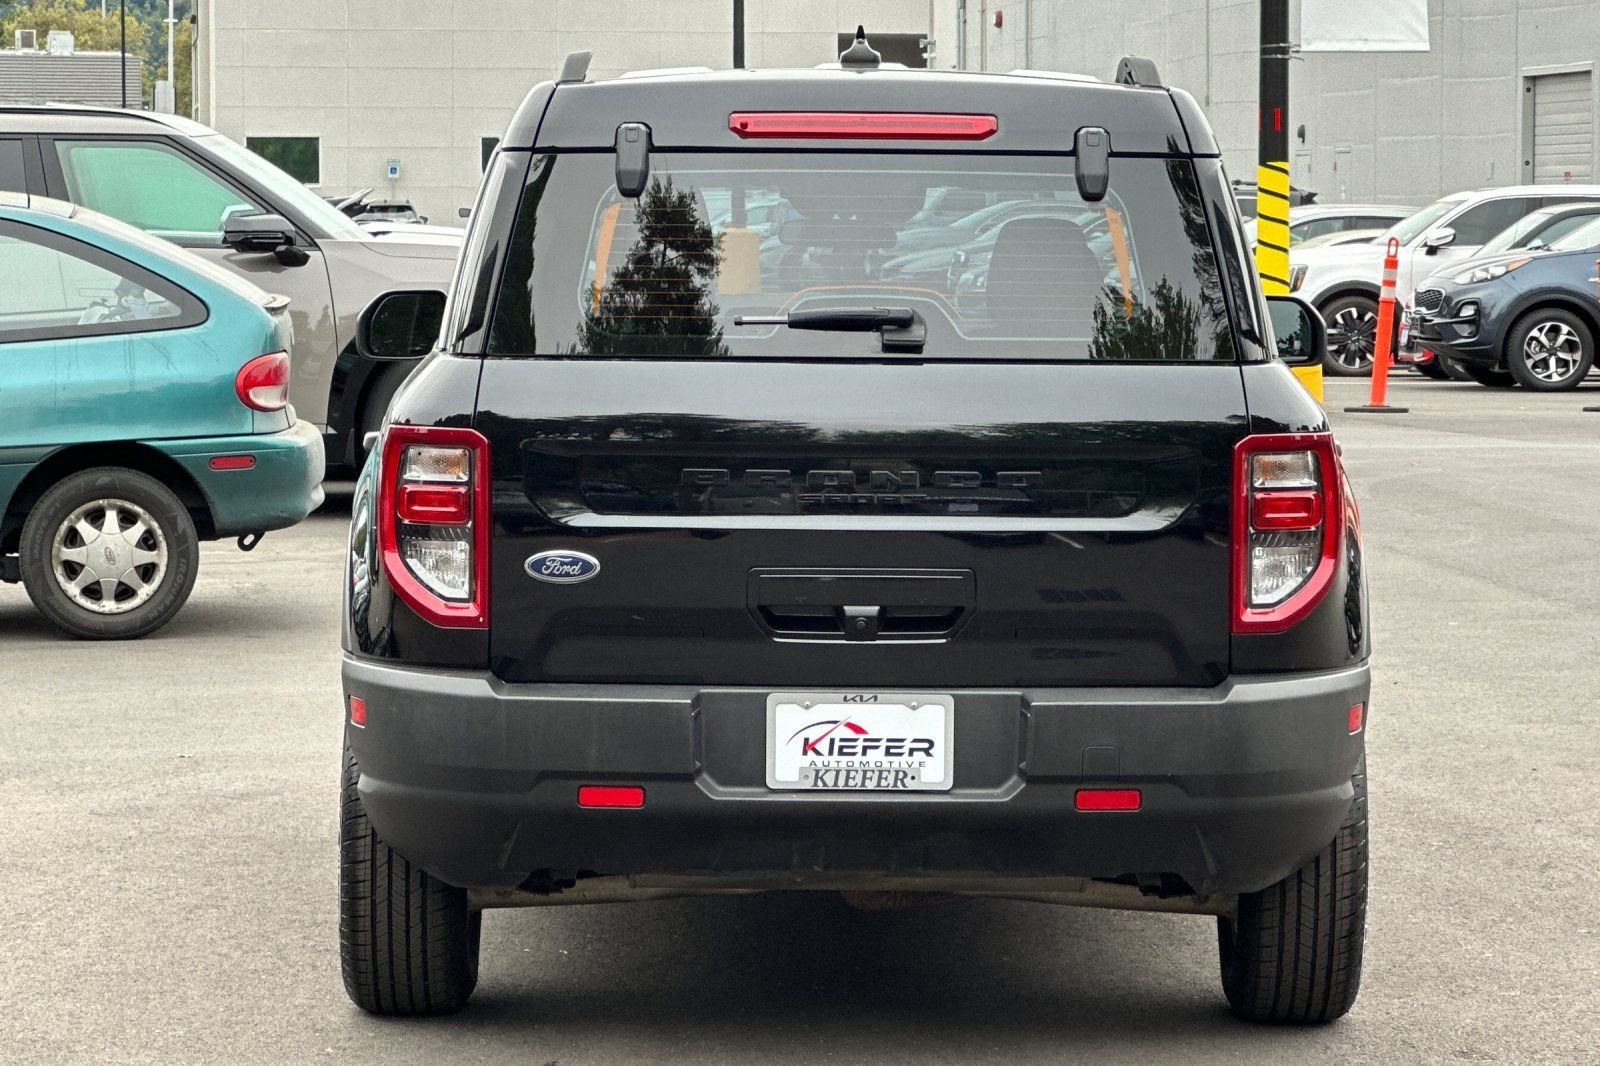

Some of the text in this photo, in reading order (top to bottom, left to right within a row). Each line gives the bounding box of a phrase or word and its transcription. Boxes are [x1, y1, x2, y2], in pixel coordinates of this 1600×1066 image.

[541, 556, 583, 575] Ford
[801, 737, 935, 758] KIEFER
[808, 760, 927, 768] AUTOMOTIVE
[811, 768, 909, 789] KIEFER
